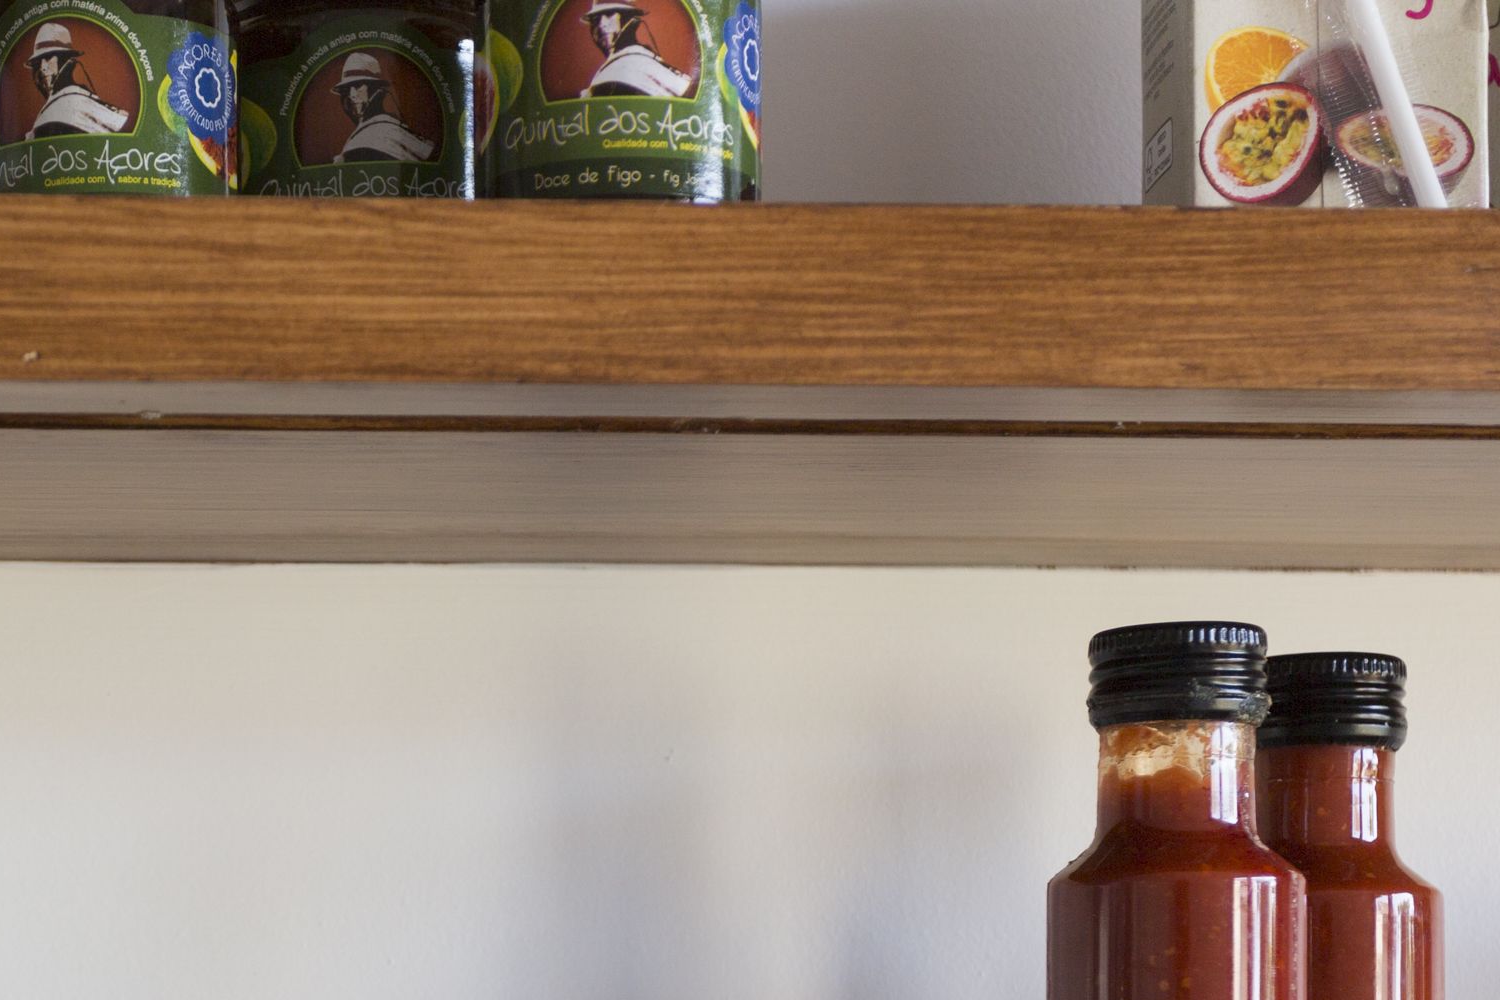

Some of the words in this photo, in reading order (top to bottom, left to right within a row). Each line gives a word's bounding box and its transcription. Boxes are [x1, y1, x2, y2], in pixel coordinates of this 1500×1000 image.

[5, 17, 24, 39] moda
[24, 2, 49, 21] antiga
[71, 0, 105, 16] matéria
[105, 11, 129, 33] prima
[128, 32, 142, 49] dos
[138, 49, 154, 82] Açores
[330, 31, 357, 48] antiga
[177, 43, 222, 80] AÇORES
[178, 89, 214, 132] CERTIFICADO
[504, 103, 589, 150] Quintal
[599, 104, 650, 135] dos
[41, 145, 88, 174] dos
[94, 139, 182, 184] Açores
[602, 138, 648, 149] Qualidade
[649, 139, 668, 149] com
[44, 176, 85, 187] Qualidade
[87, 176, 106, 184] com
[118, 175, 141, 184] sabor
[534, 172, 571, 190] Doce
[578, 167, 599, 185] de
